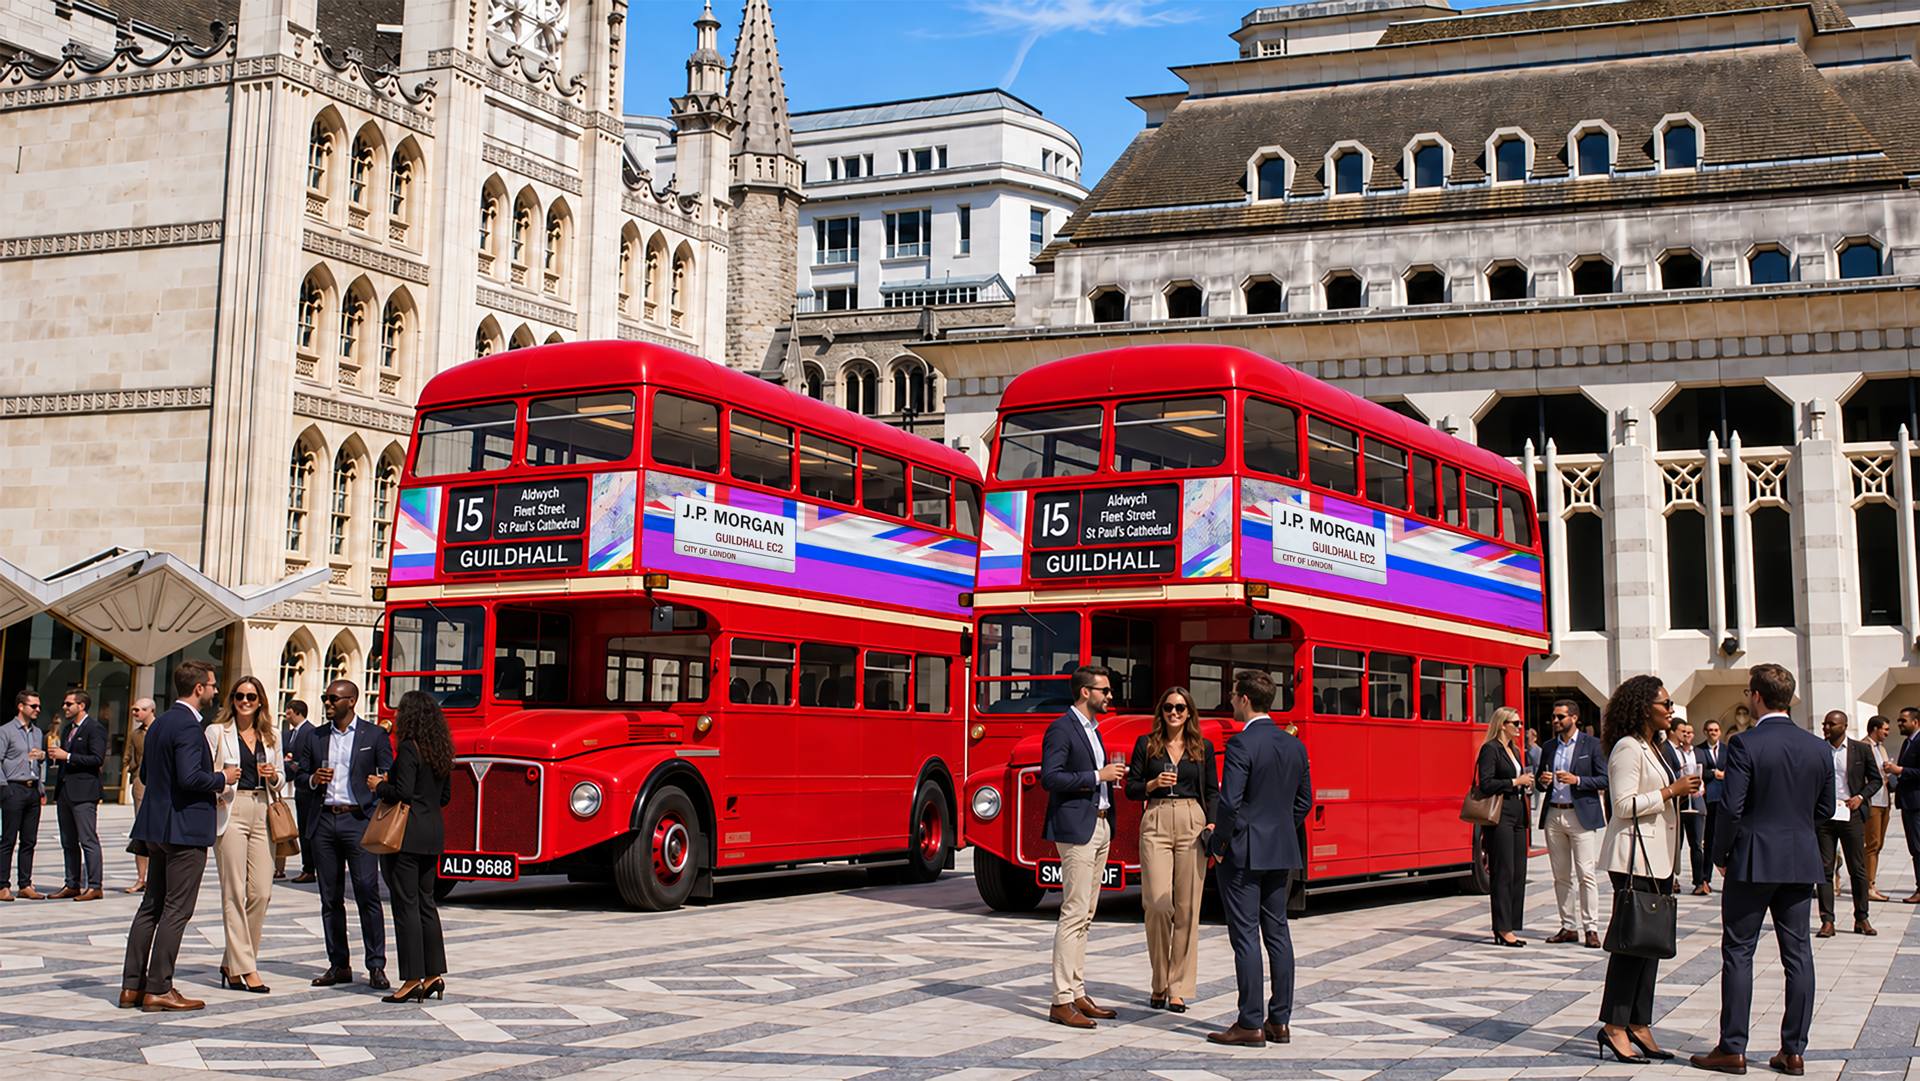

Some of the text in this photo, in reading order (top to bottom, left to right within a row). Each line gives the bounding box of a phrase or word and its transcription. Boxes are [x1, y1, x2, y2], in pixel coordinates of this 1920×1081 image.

[521, 486, 560, 502] Aldwych
[1107, 492, 1148, 508] Aldwych
[456, 497, 484, 532] 15
[537, 503, 566, 515] Street
[1100, 509, 1157, 523] Fleet Street
[498, 517, 580, 534] St Paul's Cathedral
[683, 503, 784, 536] J.P. MORGAN
[1042, 502, 1070, 537] 15
[1280, 510, 1375, 548] J.P. MORGAN
[1086, 523, 1172, 539] St Paul's Cathedral
[683, 544, 737, 560] CITY OF LONDON
[715, 532, 784, 554] GUILDHALL EC2
[460, 544, 569, 568] GUILDHALL
[1046, 550, 1161, 573] GUILDHALL
[1282, 553, 1333, 571] CITY OF LONDON
[1312, 541, 1376, 565] GUILDHALL EC2
[443, 857, 512, 876] ALD 9688
